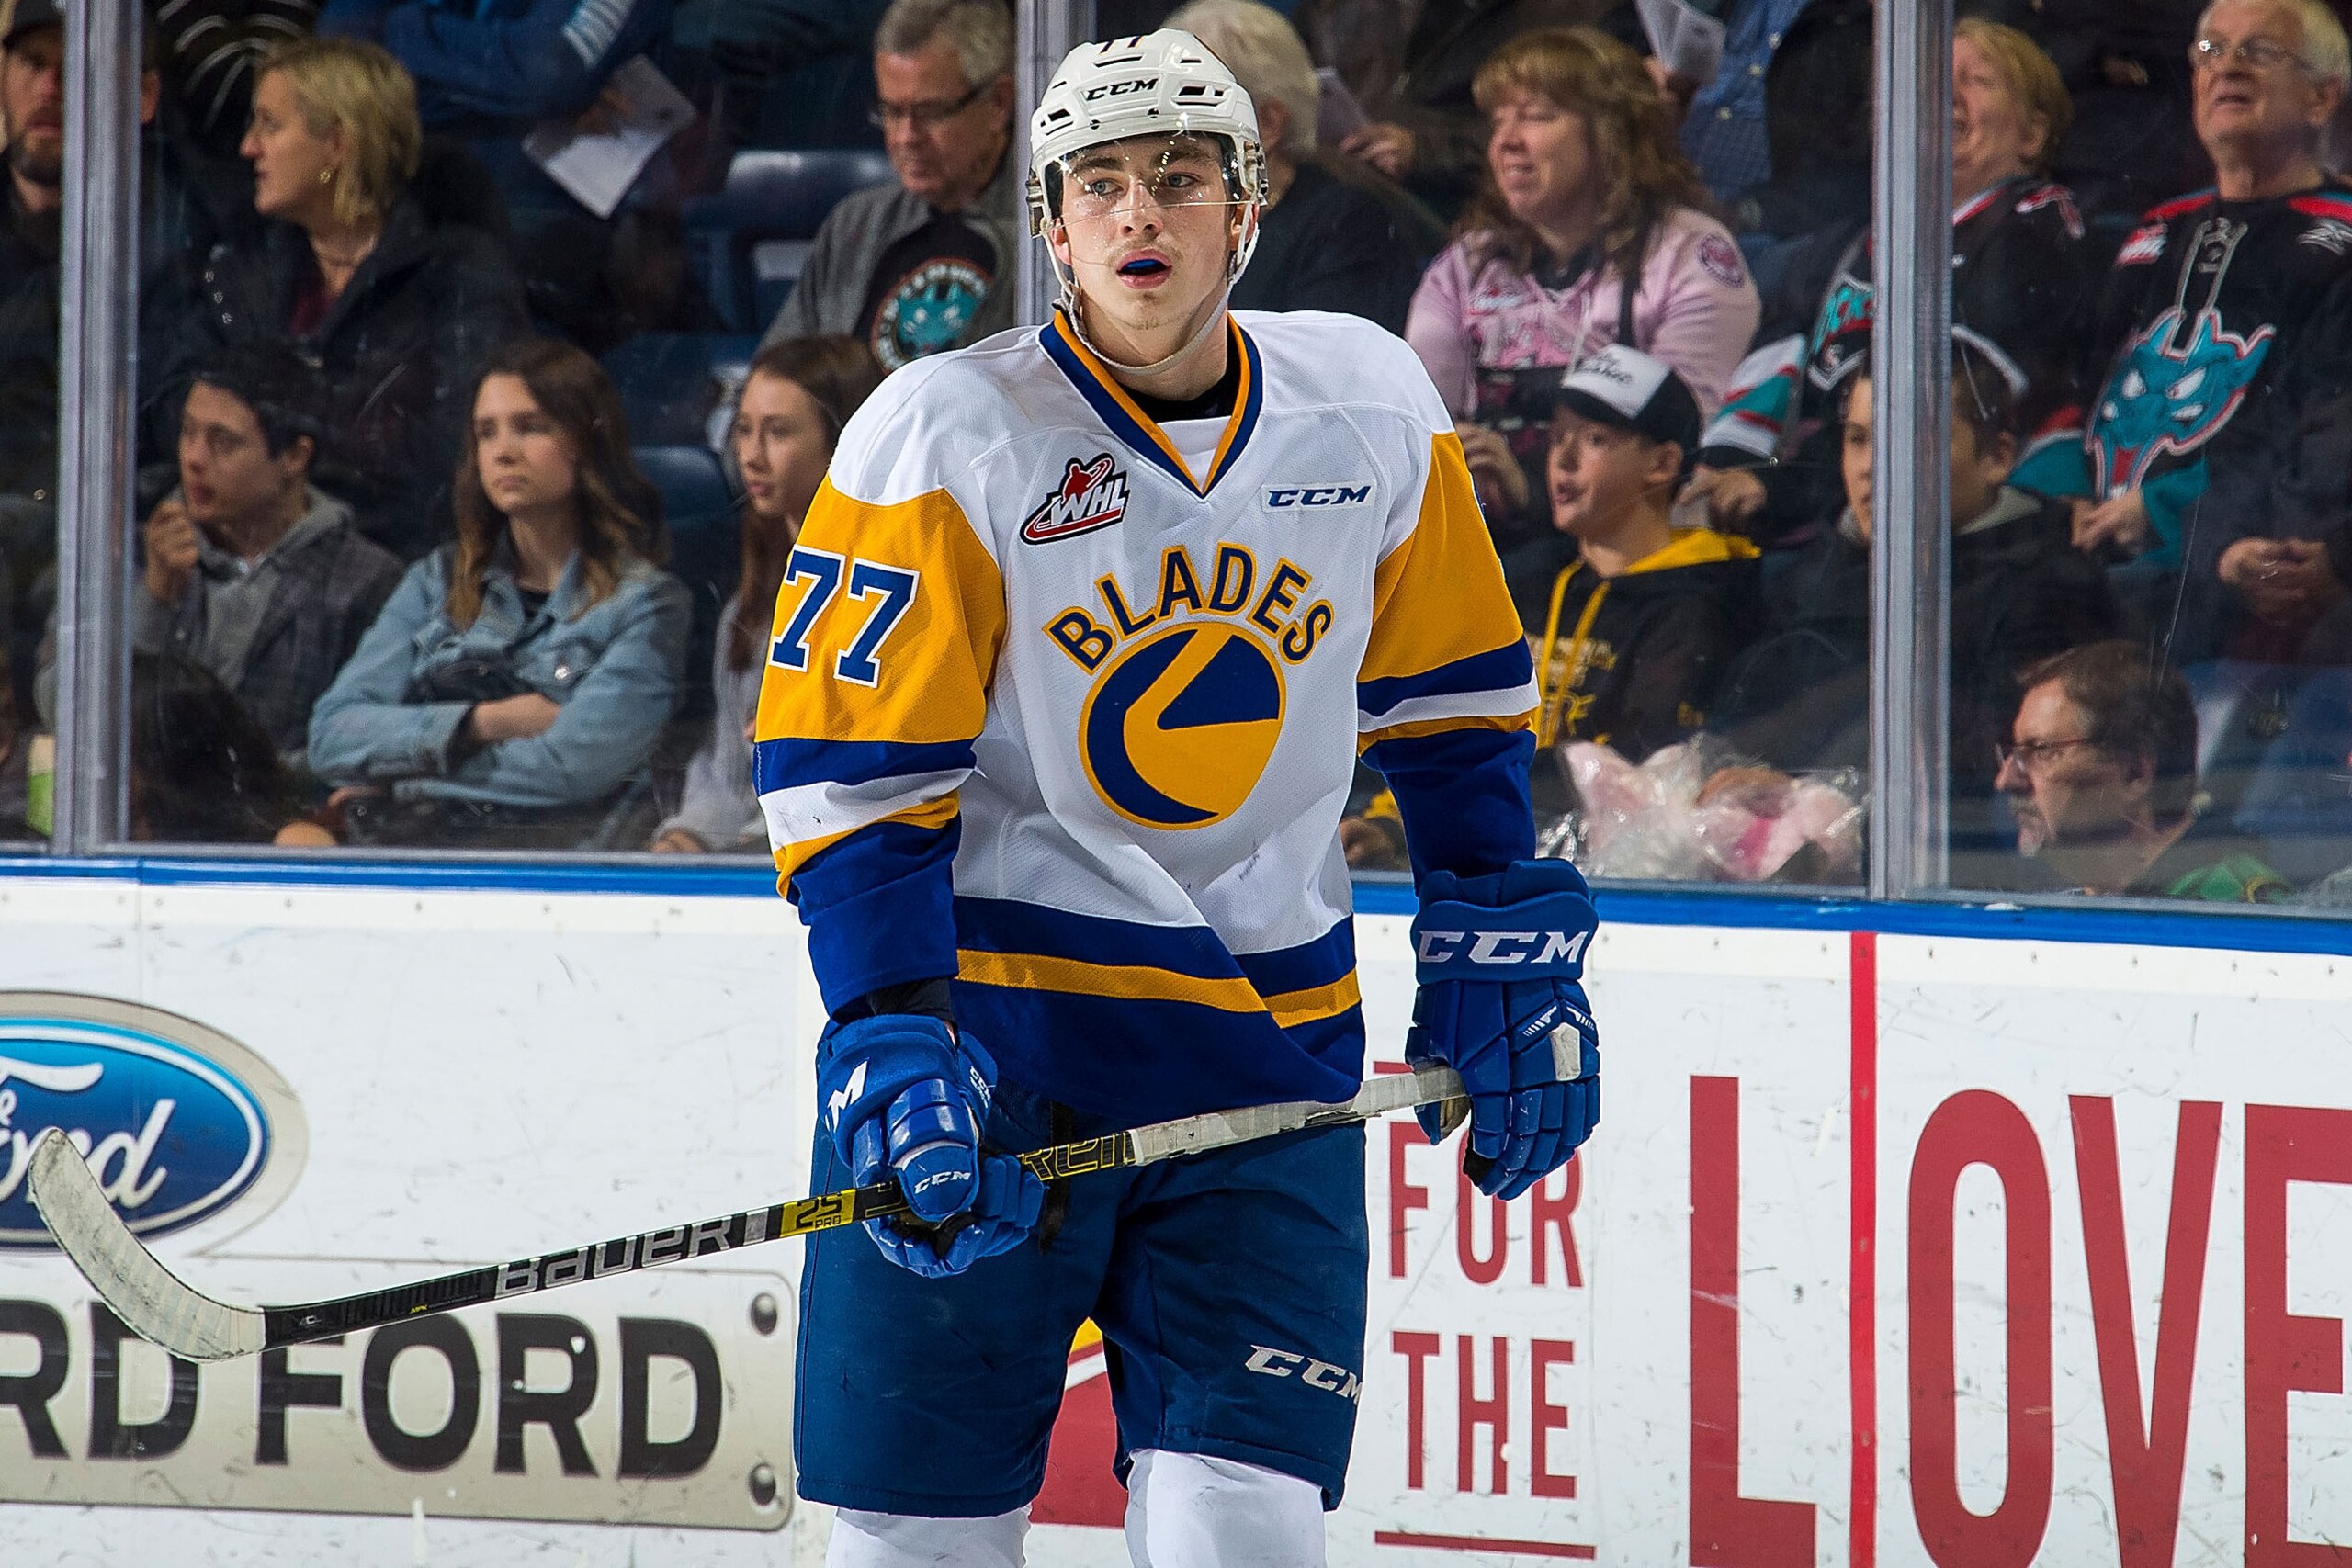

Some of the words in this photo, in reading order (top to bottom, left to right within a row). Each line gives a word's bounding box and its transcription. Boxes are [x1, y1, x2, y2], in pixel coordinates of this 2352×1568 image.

[1086, 78, 1159, 101] CCM
[1051, 478, 1126, 526] WHL
[1267, 485, 1371, 507] CCM
[768, 544, 920, 688] 77
[1042, 541, 1335, 676] BLADES
[1418, 930, 1589, 964] CCM
[914, 1170, 971, 1194] CCM
[1388, 1121, 1584, 1289] FOR
[814, 1214, 842, 1229] PRO
[1690, 1075, 2352, 1568] LOVE
[254, 1311, 724, 1481] FORD
[1245, 1345, 1364, 1405] CCM
[1391, 1330, 1578, 1500] THE
